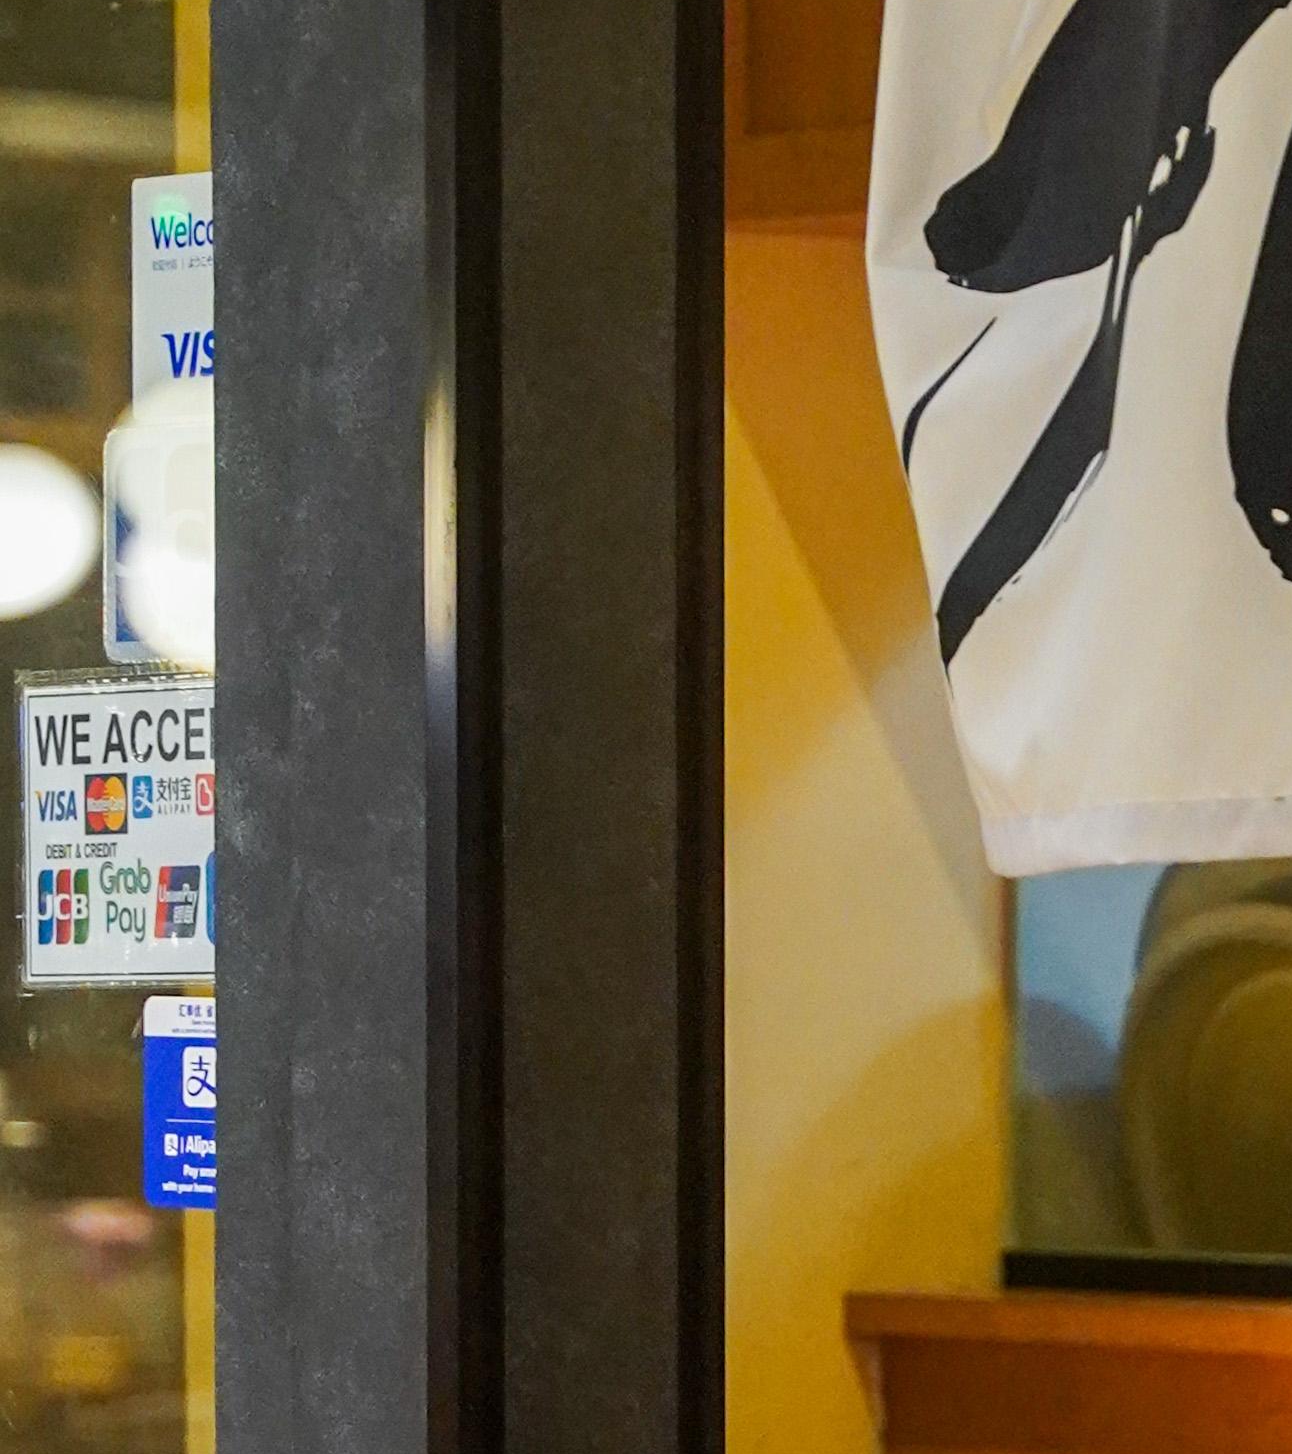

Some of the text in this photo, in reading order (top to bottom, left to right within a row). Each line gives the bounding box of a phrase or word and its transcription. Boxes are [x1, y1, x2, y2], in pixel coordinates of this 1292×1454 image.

[35, 707, 215, 766] WE ACCE
[35, 790, 78, 822] VISA
[157, 803, 191, 815] ALIPAY
[46, 842, 118, 859] DEBIT & CREDIT
[100, 858, 150, 894] Grab
[37, 893, 89, 921] JCB
[106, 900, 146, 943] Pay
